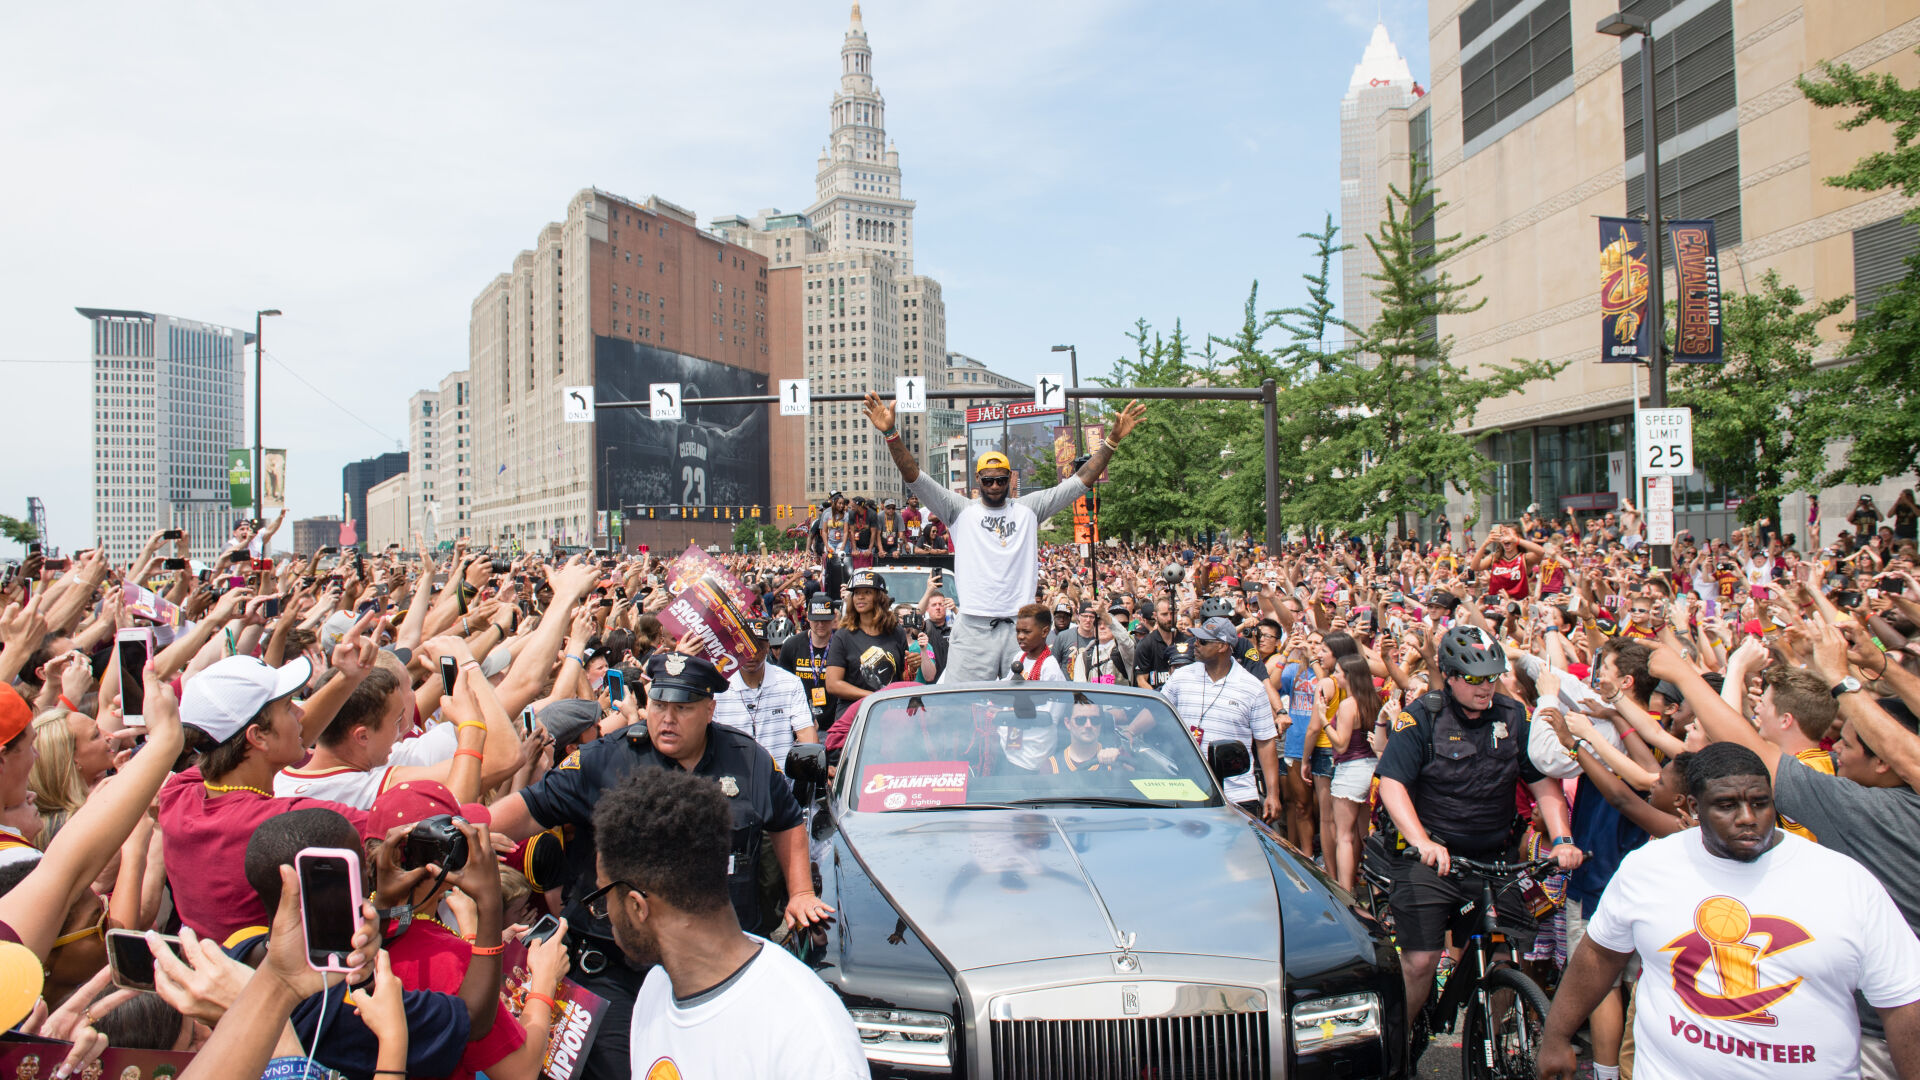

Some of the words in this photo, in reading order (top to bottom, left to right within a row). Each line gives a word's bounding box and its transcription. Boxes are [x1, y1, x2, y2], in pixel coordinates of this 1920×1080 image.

[1677, 229, 1710, 354] CAVALIERS
[1705, 256, 1720, 325] CLEVELAND
[655, 409, 677, 417] ONLY
[901, 401, 922, 409] ONLY
[976, 405, 1010, 421] JACK
[1013, 404, 1050, 414] CASIN
[568, 411, 590, 419] ONLY
[1645, 415, 1683, 425] SPEED
[1649, 429, 1679, 439] LIMIT
[679, 442, 707, 461] CLEVELAND
[1649, 445, 1684, 468] 25
[1611, 459, 1623, 475] W
[682, 466, 705, 512] 23
[984, 516, 1006, 528] NIKE
[1000, 521, 1017, 539] AIR
[673, 599, 738, 673] CHAMPIONS
[1158, 672, 1169, 682] NB
[864, 774, 966, 794] CHAMPIONS
[557, 1016, 568, 1035] 2016
[1669, 1015, 1816, 1064] VOLUNTEER
[262, 1064, 294, 1079] IGNA
